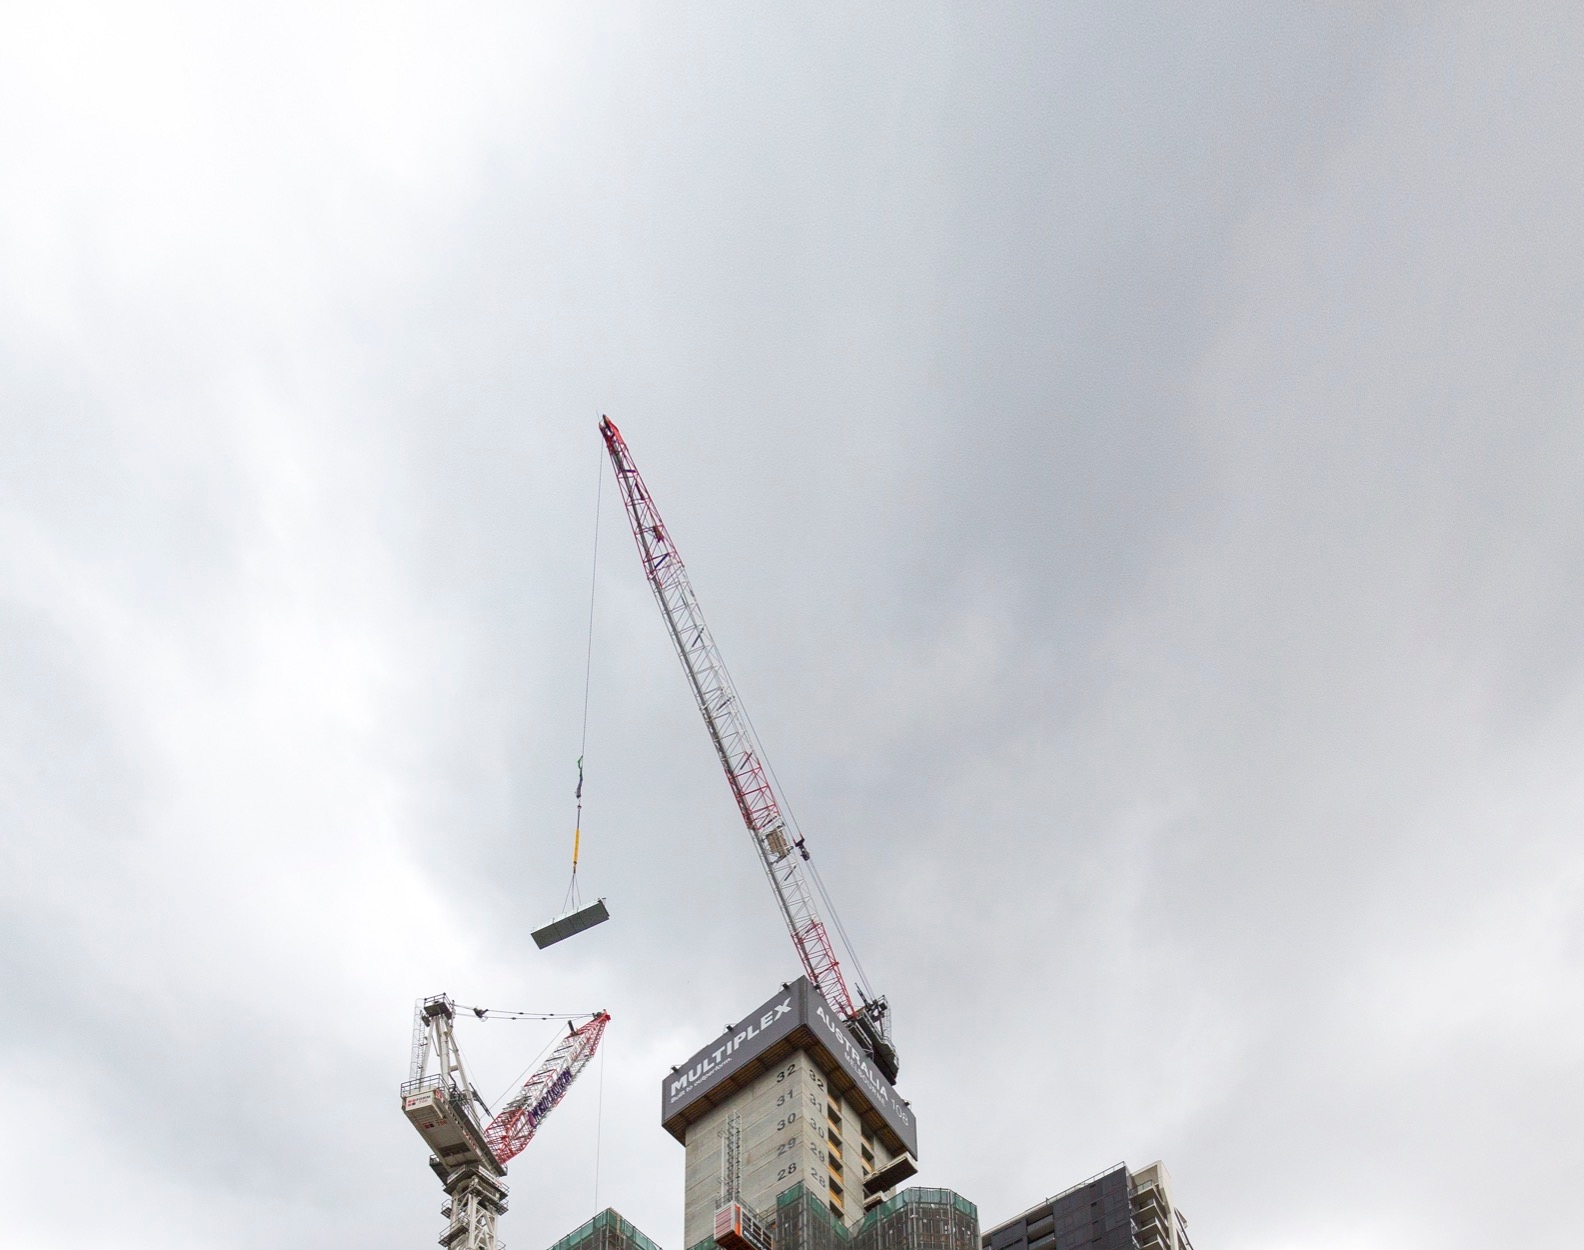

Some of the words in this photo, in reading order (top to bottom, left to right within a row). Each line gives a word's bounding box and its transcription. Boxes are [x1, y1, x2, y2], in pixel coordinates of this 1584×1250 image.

[671, 997, 792, 1097] MULTIPLEX
[776, 1063, 796, 1083] 32
[816, 1006, 889, 1101] AUSTRALIA
[890, 1099, 909, 1126] 108
[809, 1069, 824, 1092] 32
[844, 1051, 886, 1107] MELBOURNE
[776, 1089, 793, 1107] 31
[810, 1093, 823, 1113] 31
[776, 1112, 796, 1131] 30
[810, 1117, 825, 1139] 30
[777, 1137, 797, 1157] 29
[810, 1142, 825, 1162] 29
[777, 1162, 797, 1181] 28
[810, 1167, 826, 1189] 28
